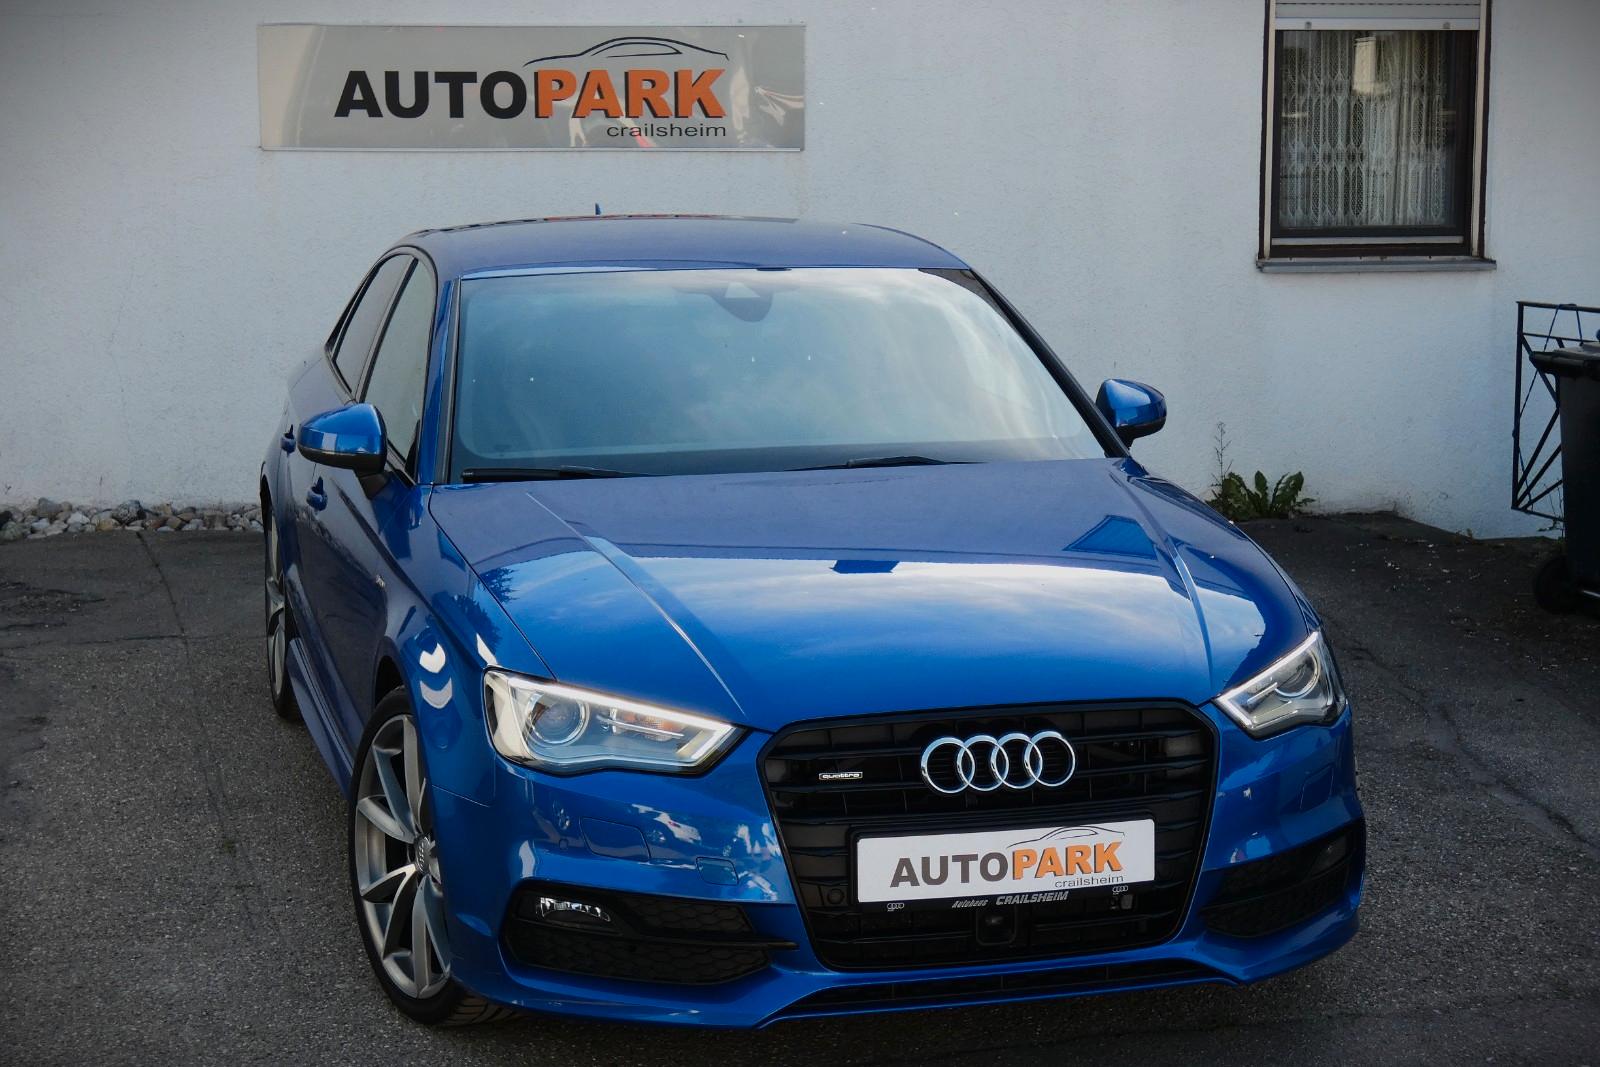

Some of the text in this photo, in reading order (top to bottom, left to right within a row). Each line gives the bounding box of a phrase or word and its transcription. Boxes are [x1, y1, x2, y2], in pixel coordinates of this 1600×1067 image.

[334, 69, 727, 119] AUTOPARK
[606, 123, 727, 137] crailsheim
[890, 841, 1123, 888] AUTOPARK
[1054, 873, 1125, 889] crailsheim
[995, 890, 1069, 906] CRAILSHEIM
